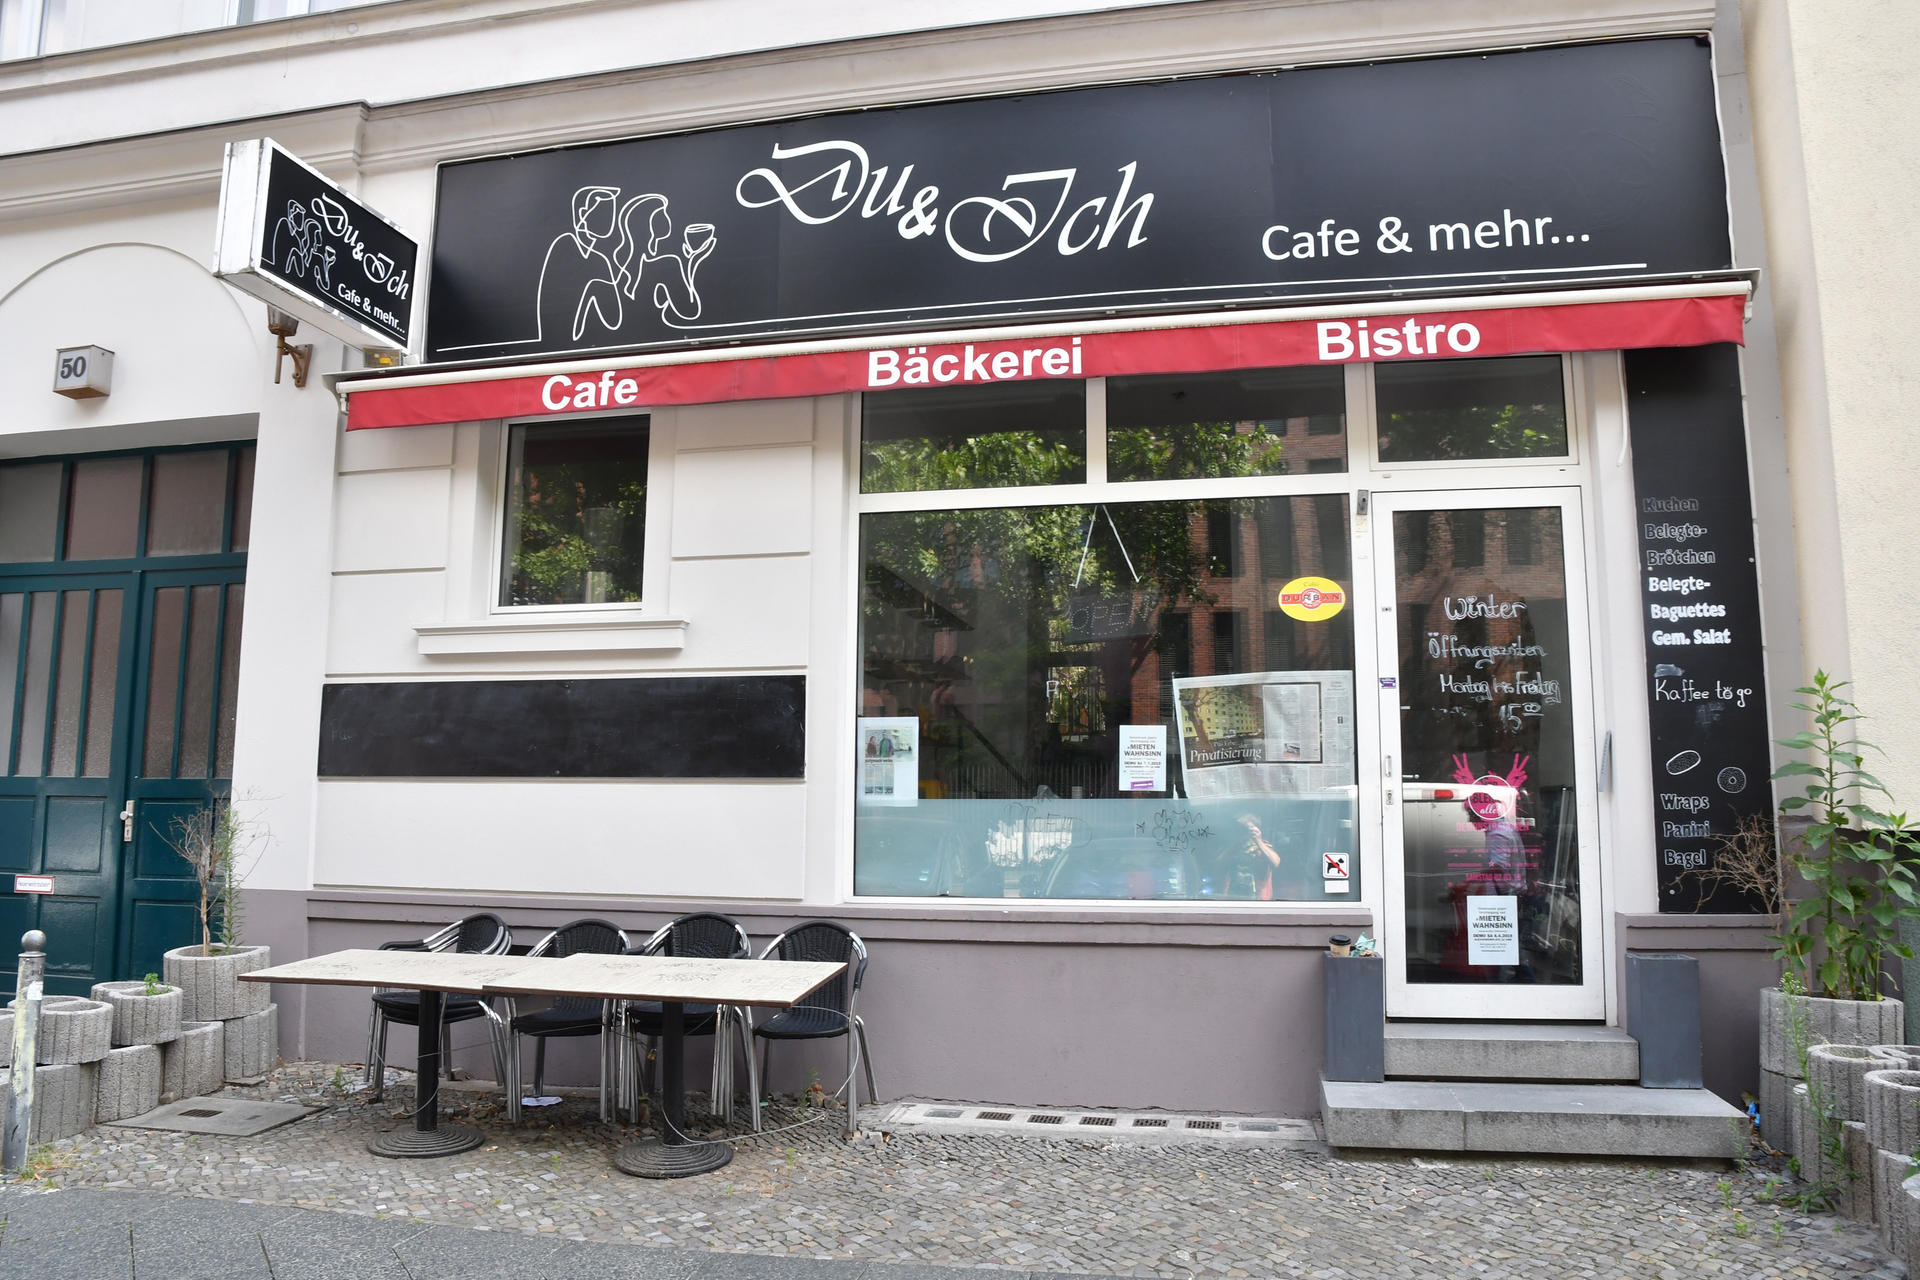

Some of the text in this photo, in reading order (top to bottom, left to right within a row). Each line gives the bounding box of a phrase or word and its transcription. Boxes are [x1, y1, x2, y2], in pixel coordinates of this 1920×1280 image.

[736, 139, 915, 225] Du
[945, 160, 1155, 263] Ich
[311, 192, 359, 247] Du
[363, 252, 410, 300] Ich
[1261, 208, 1591, 262] Cafe & mehr...
[338, 283, 361, 307] Cafe
[362, 298, 372, 313] &
[1316, 316, 1481, 361] Bistro
[60, 356, 87, 379] 50
[867, 336, 1084, 388] Bäckerei
[541, 370, 639, 412] Cafe
[1643, 496, 1699, 513] Kuchen
[1644, 523, 1708, 542] Belegte-
[1647, 548, 1716, 566] Brötchen
[1649, 576, 1711, 595] Belegte-
[1444, 594, 1527, 621] Winter
[1650, 602, 1726, 622] Baguettes
[1652, 628, 1732, 645] Gem. Salat
[1440, 674, 1493, 703] Montag
[1655, 678, 1710, 702] Kaffee
[1736, 687, 1753, 707] go
[1190, 747, 1262, 763] Privatisierung
[1660, 793, 1710, 814] Wraps
[1663, 821, 1711, 838] Panini
[1664, 849, 1707, 869] Bagel
